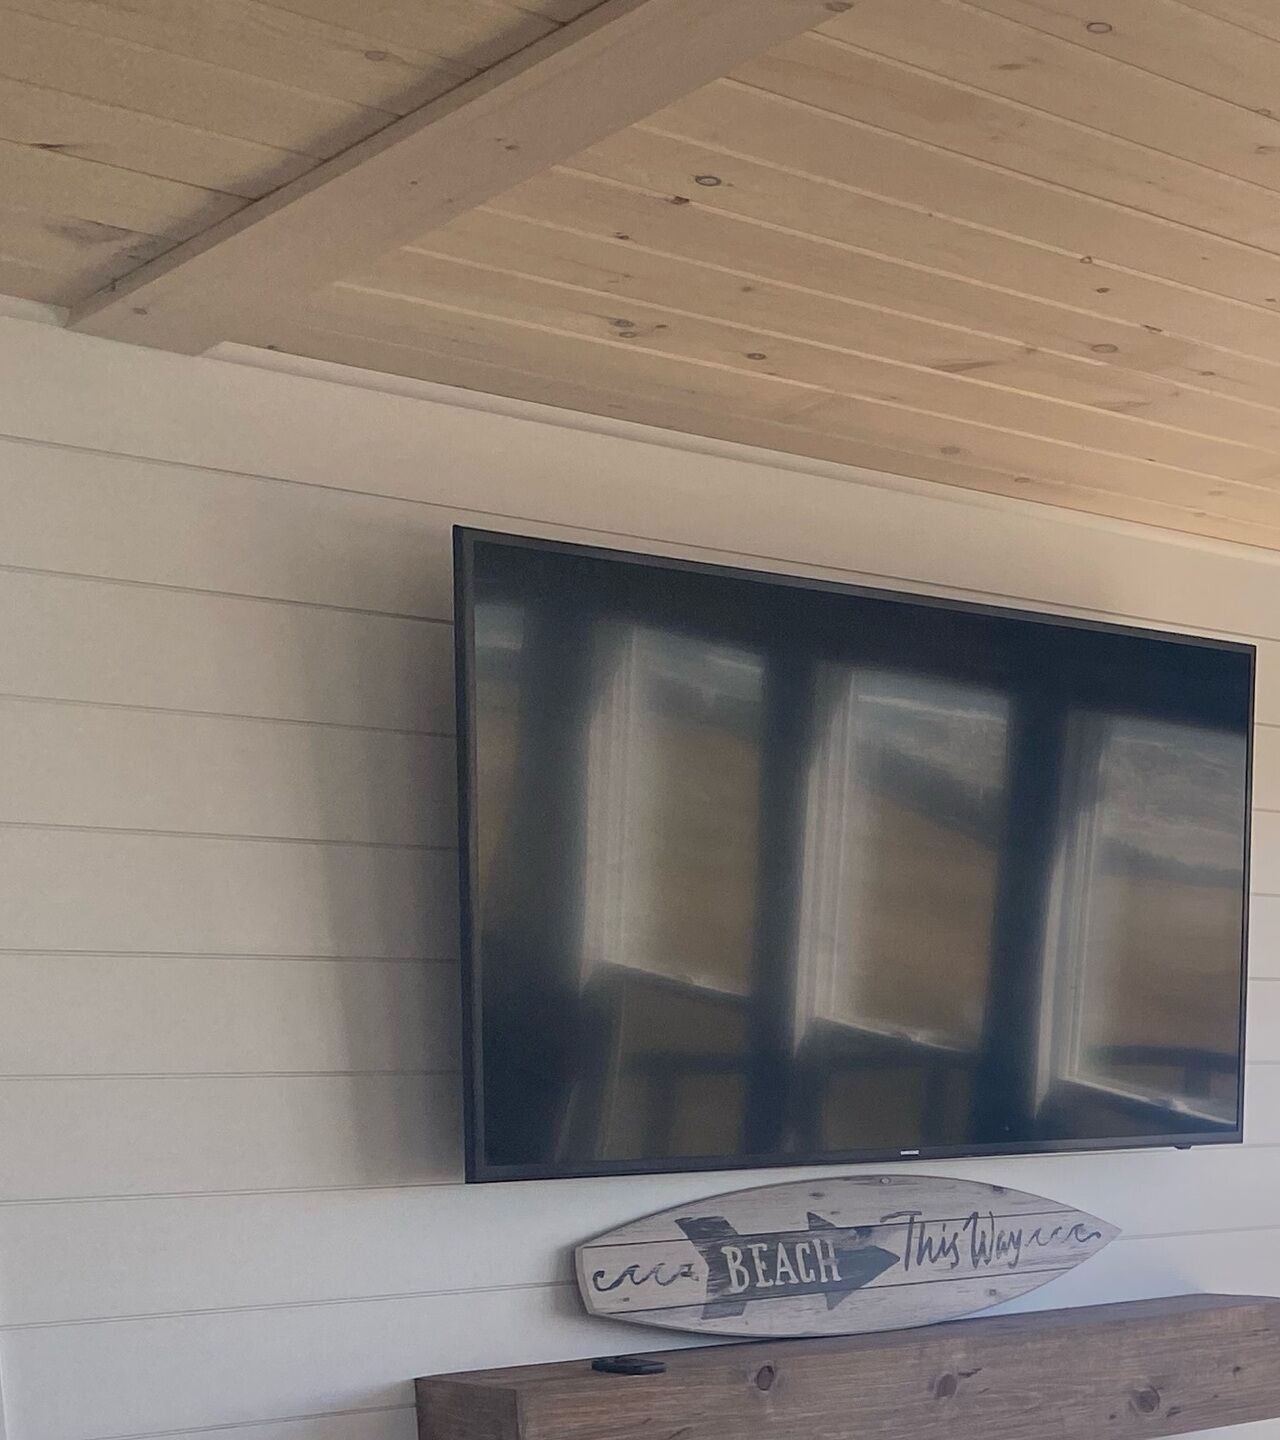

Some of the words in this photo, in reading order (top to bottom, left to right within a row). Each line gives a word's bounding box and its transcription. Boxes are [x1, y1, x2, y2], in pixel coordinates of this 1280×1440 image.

[721, 1239, 842, 1294] BEACH
[880, 1211, 960, 1271] This
[963, 1211, 1022, 1269] Way
